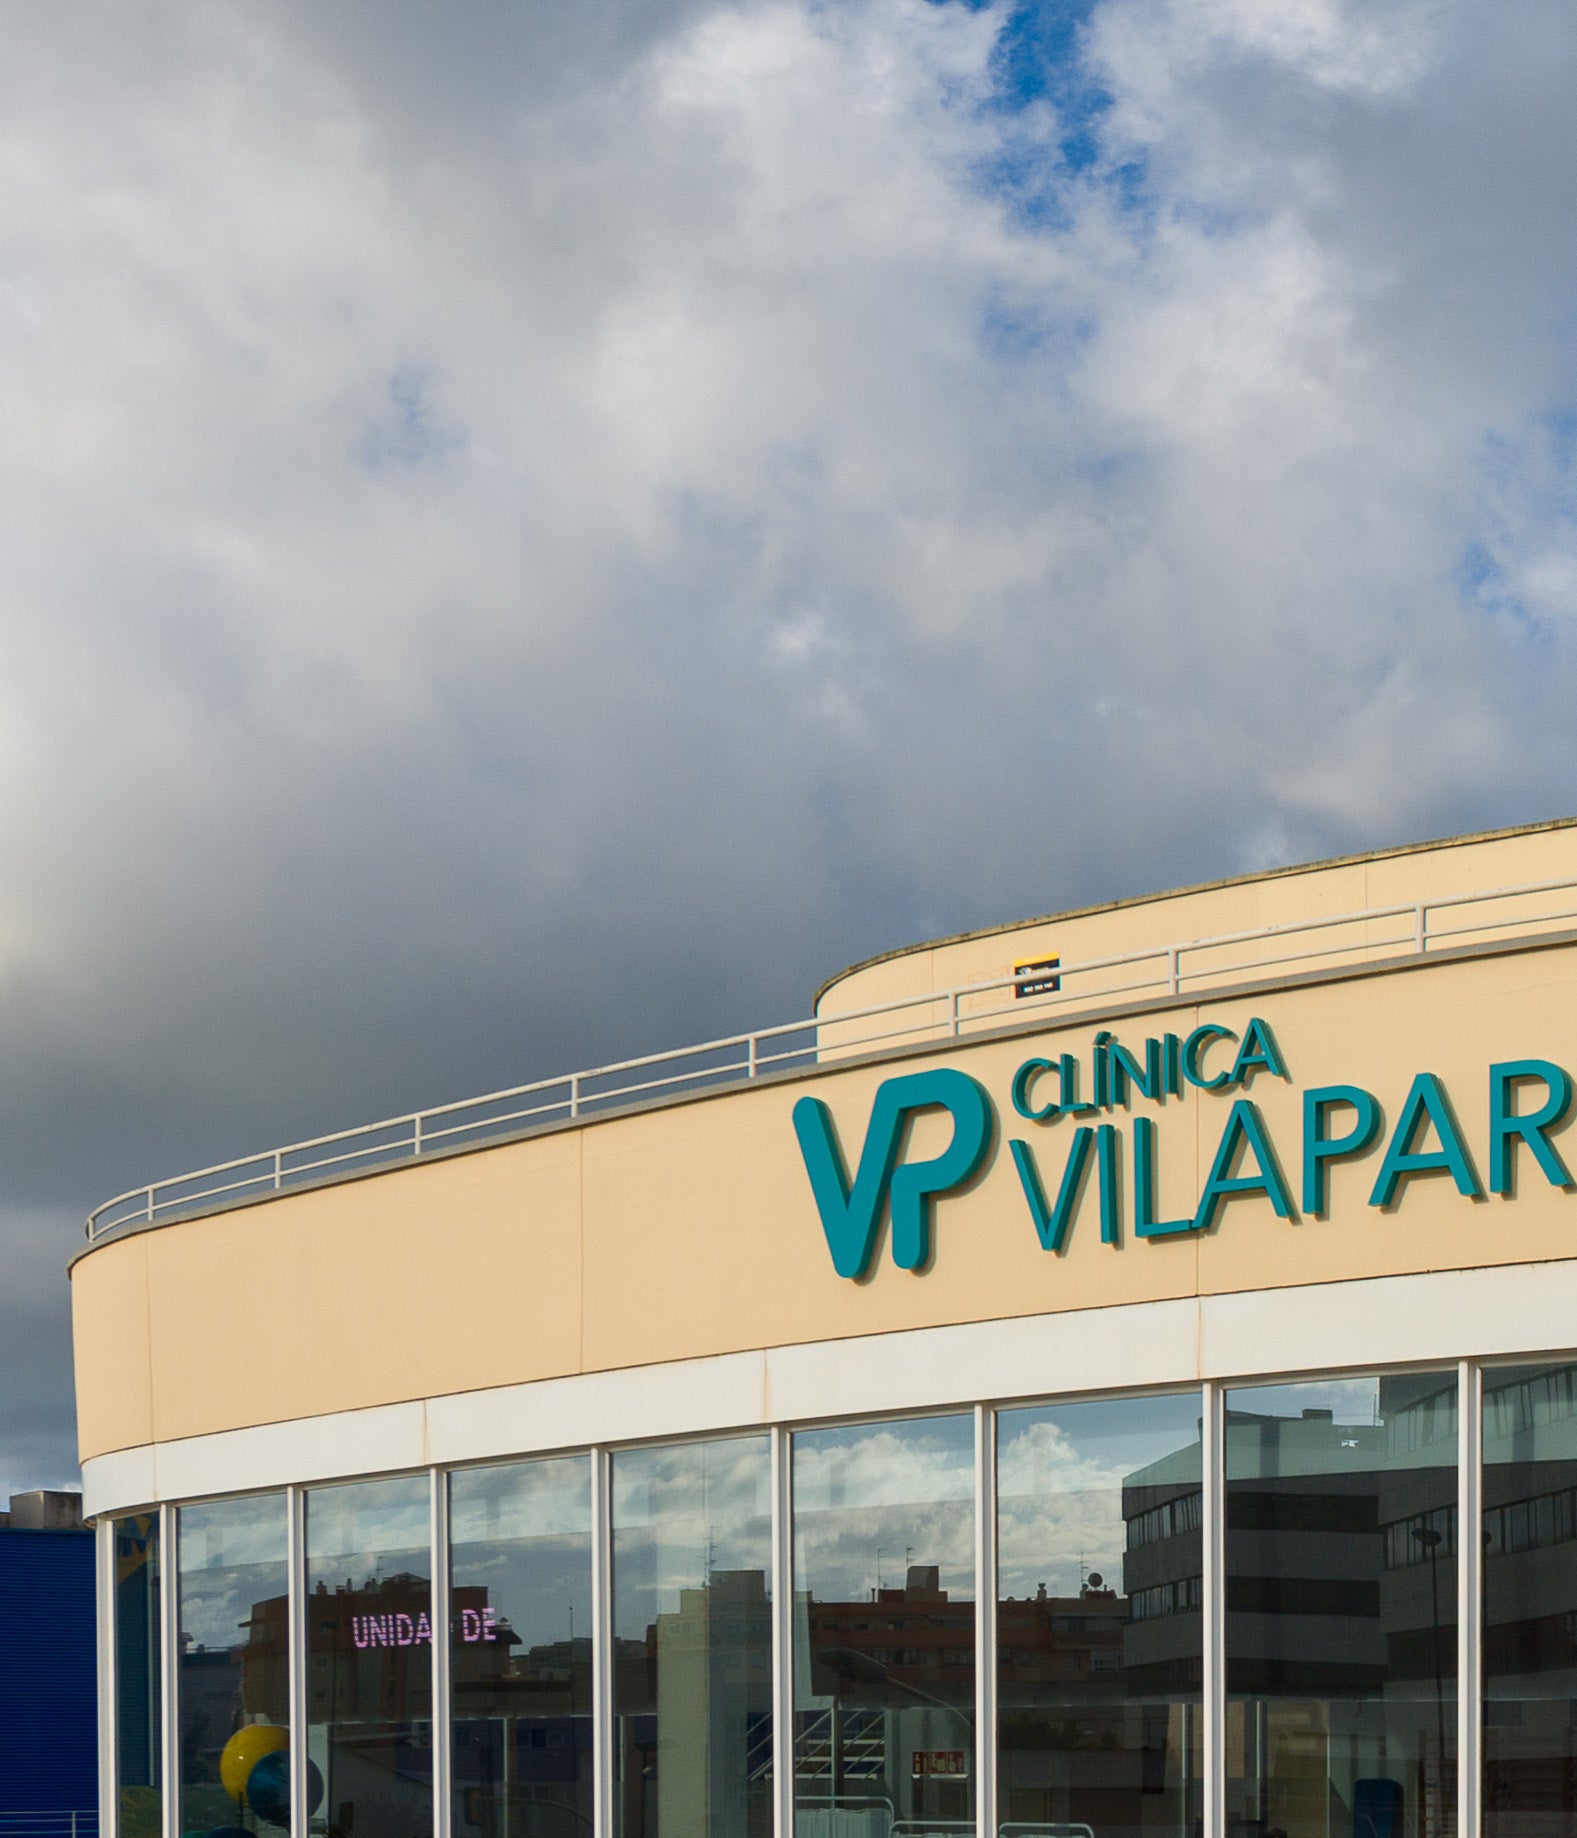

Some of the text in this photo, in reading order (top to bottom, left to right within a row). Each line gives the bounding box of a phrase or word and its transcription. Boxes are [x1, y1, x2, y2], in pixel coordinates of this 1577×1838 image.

[1010, 1017, 1288, 1121] CLÍNICA
[791, 1067, 993, 1281] VP
[352, 1607, 497, 1648] UNIDA DE
